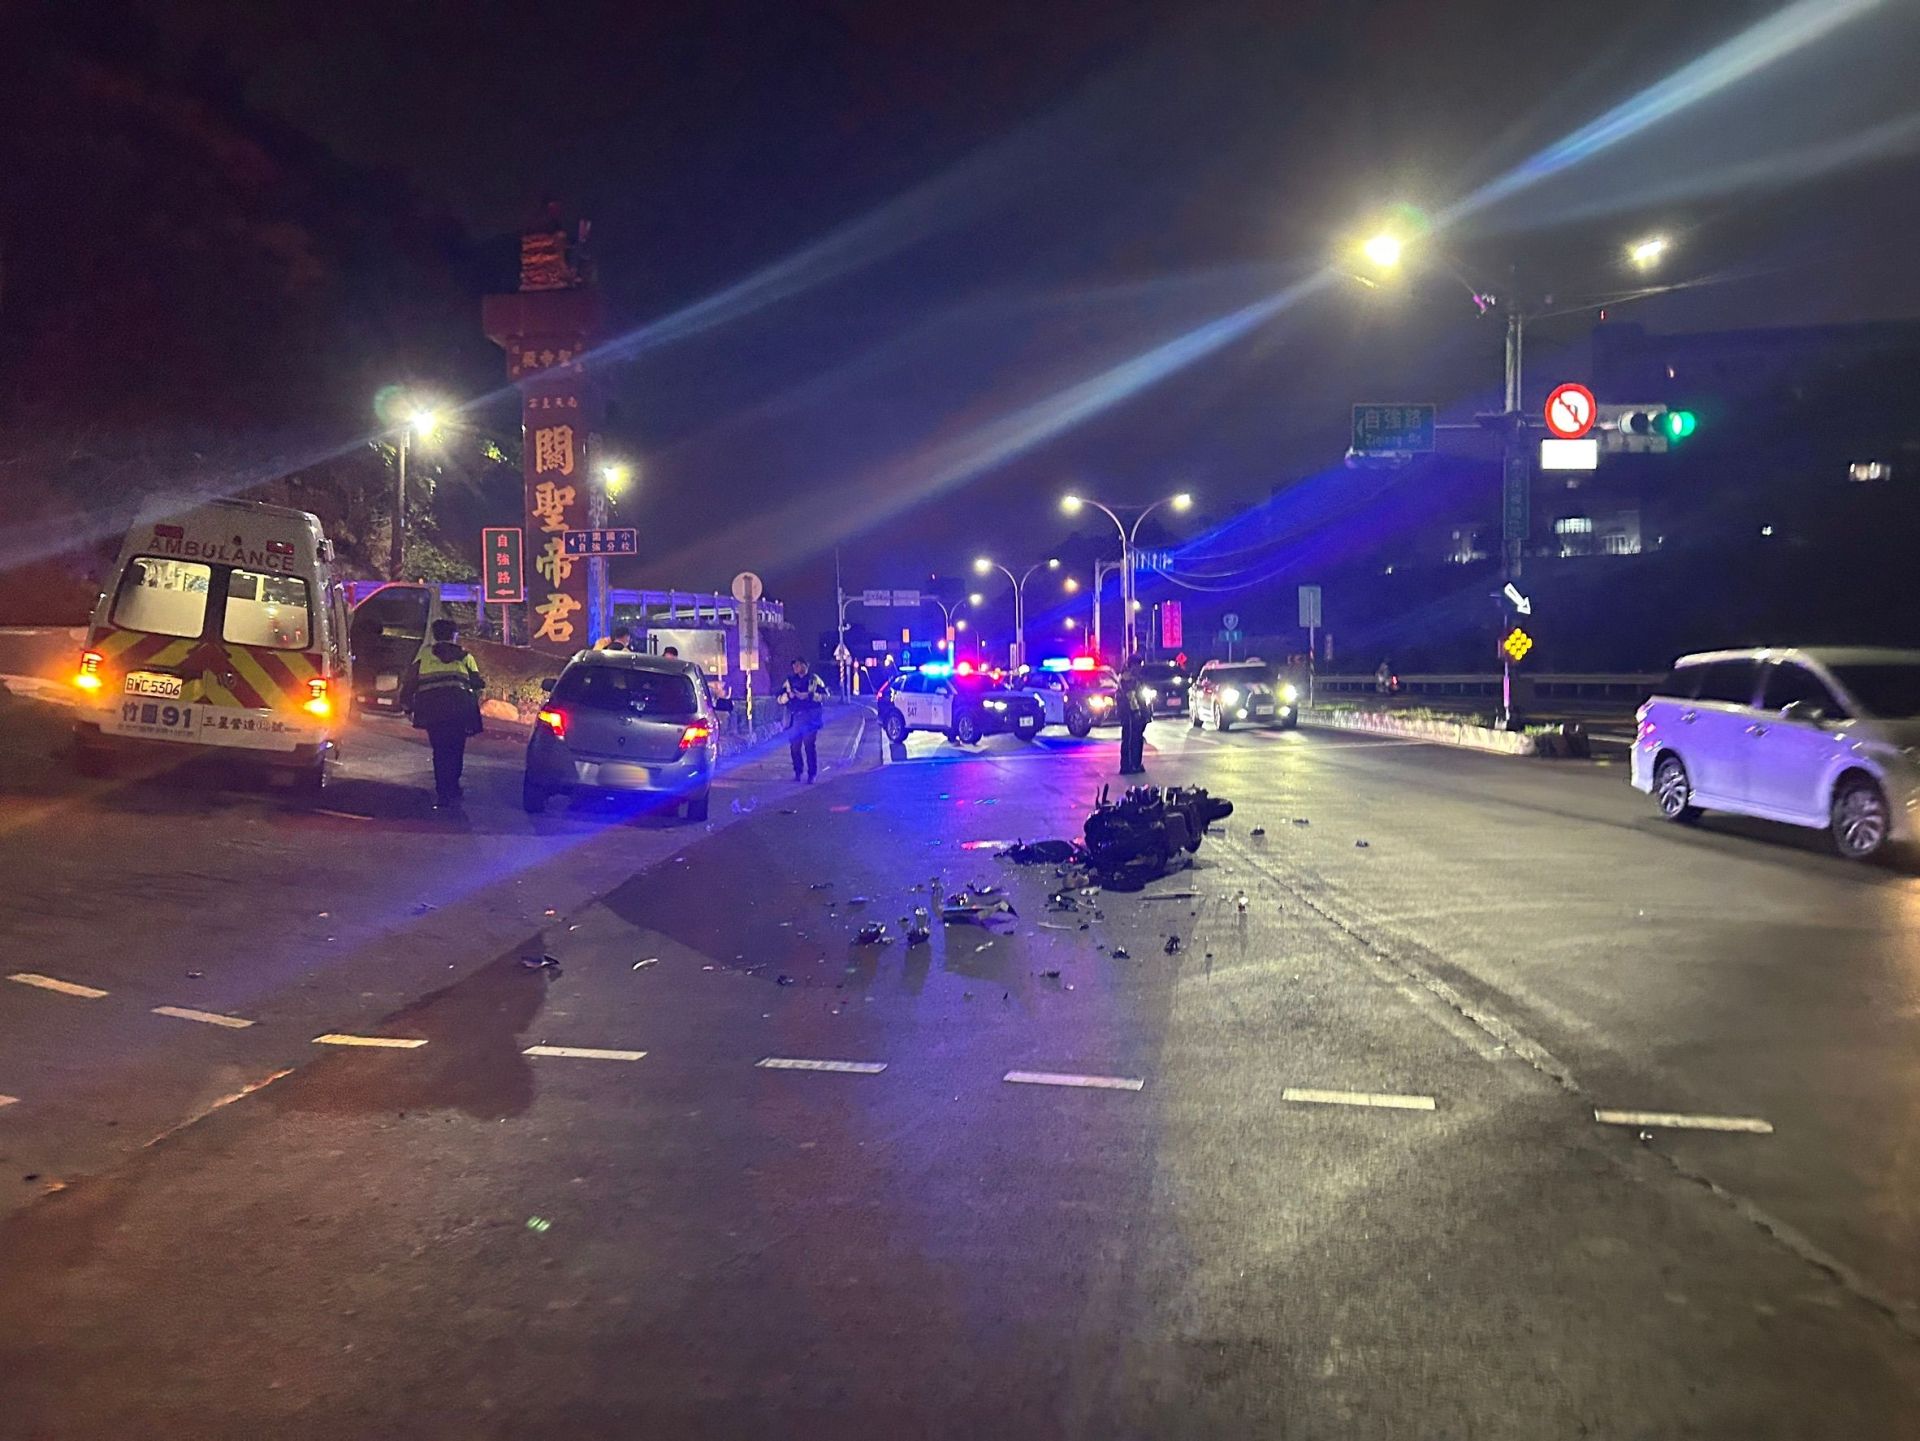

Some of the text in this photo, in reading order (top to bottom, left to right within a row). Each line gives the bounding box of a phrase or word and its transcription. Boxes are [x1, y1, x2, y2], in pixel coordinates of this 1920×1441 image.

[147, 538, 295, 572] AMBULANCE
[497, 534, 511, 584] 自強路
